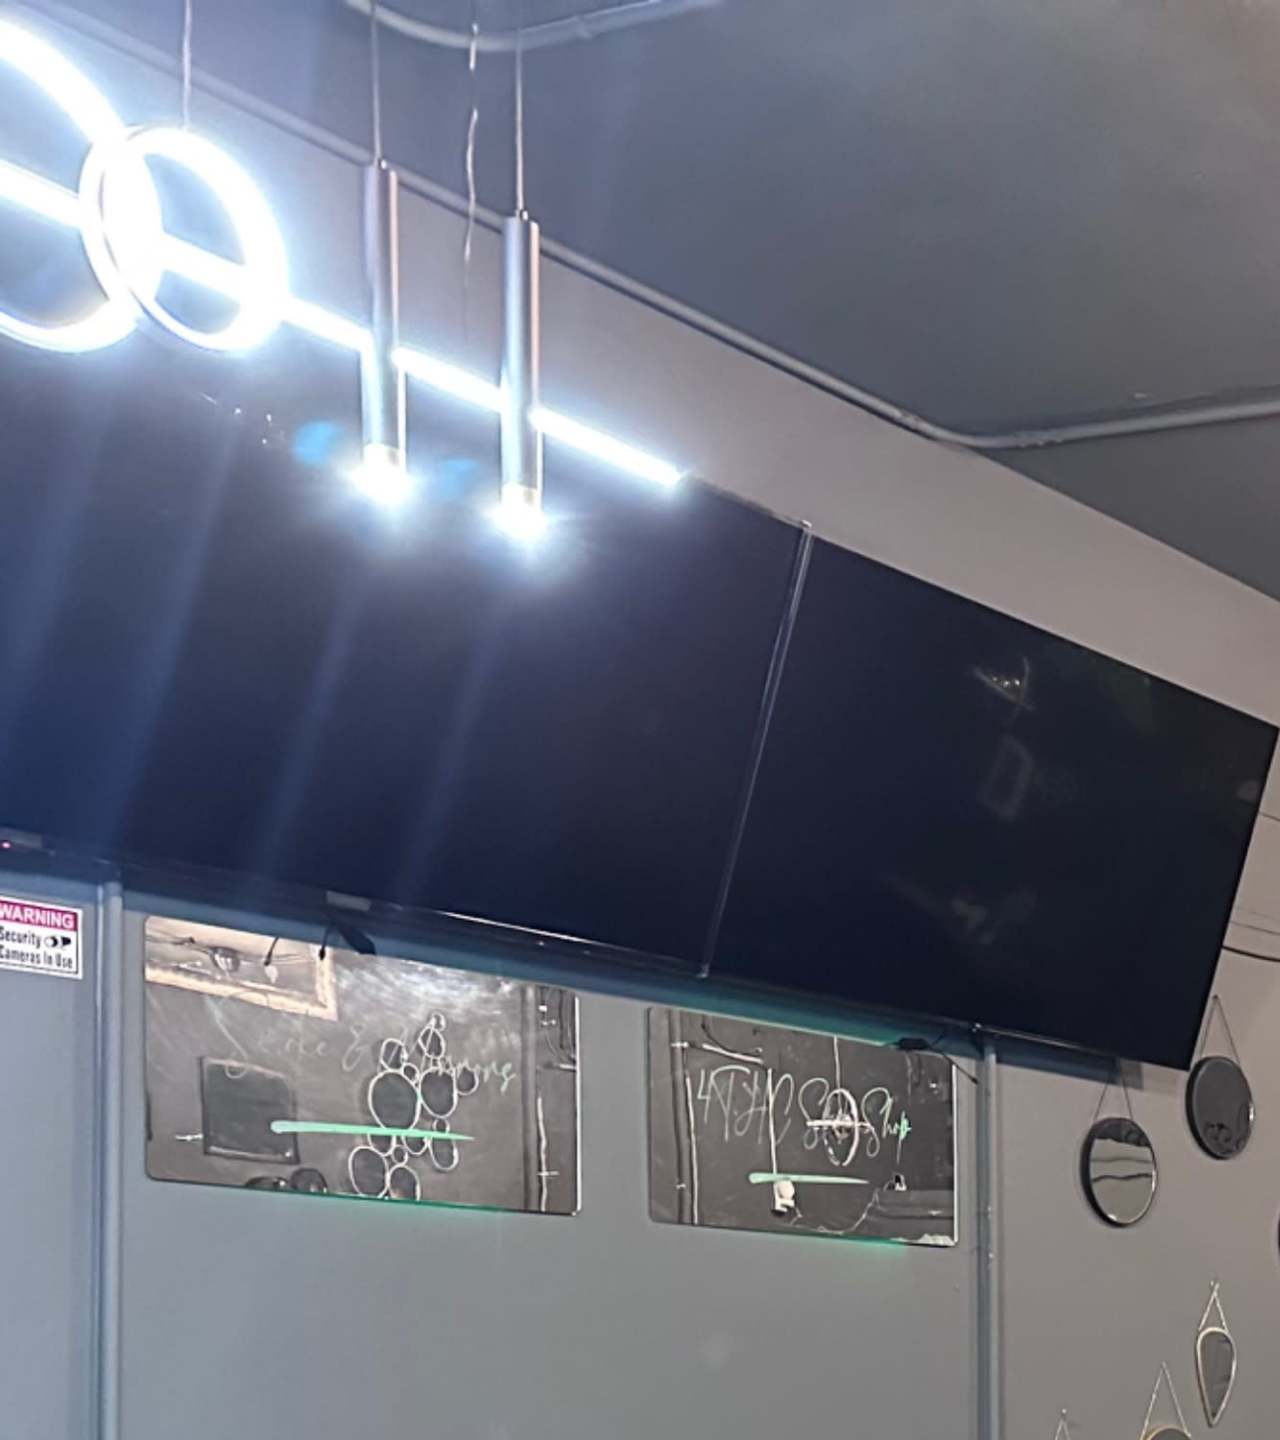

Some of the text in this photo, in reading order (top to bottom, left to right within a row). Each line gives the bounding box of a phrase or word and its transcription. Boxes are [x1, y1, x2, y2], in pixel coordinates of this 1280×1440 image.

[0, 902, 75, 929] WARNING
[0, 926, 41, 949] Security
[0, 944, 41, 965] Cameras
[55, 953, 73, 969] Use
